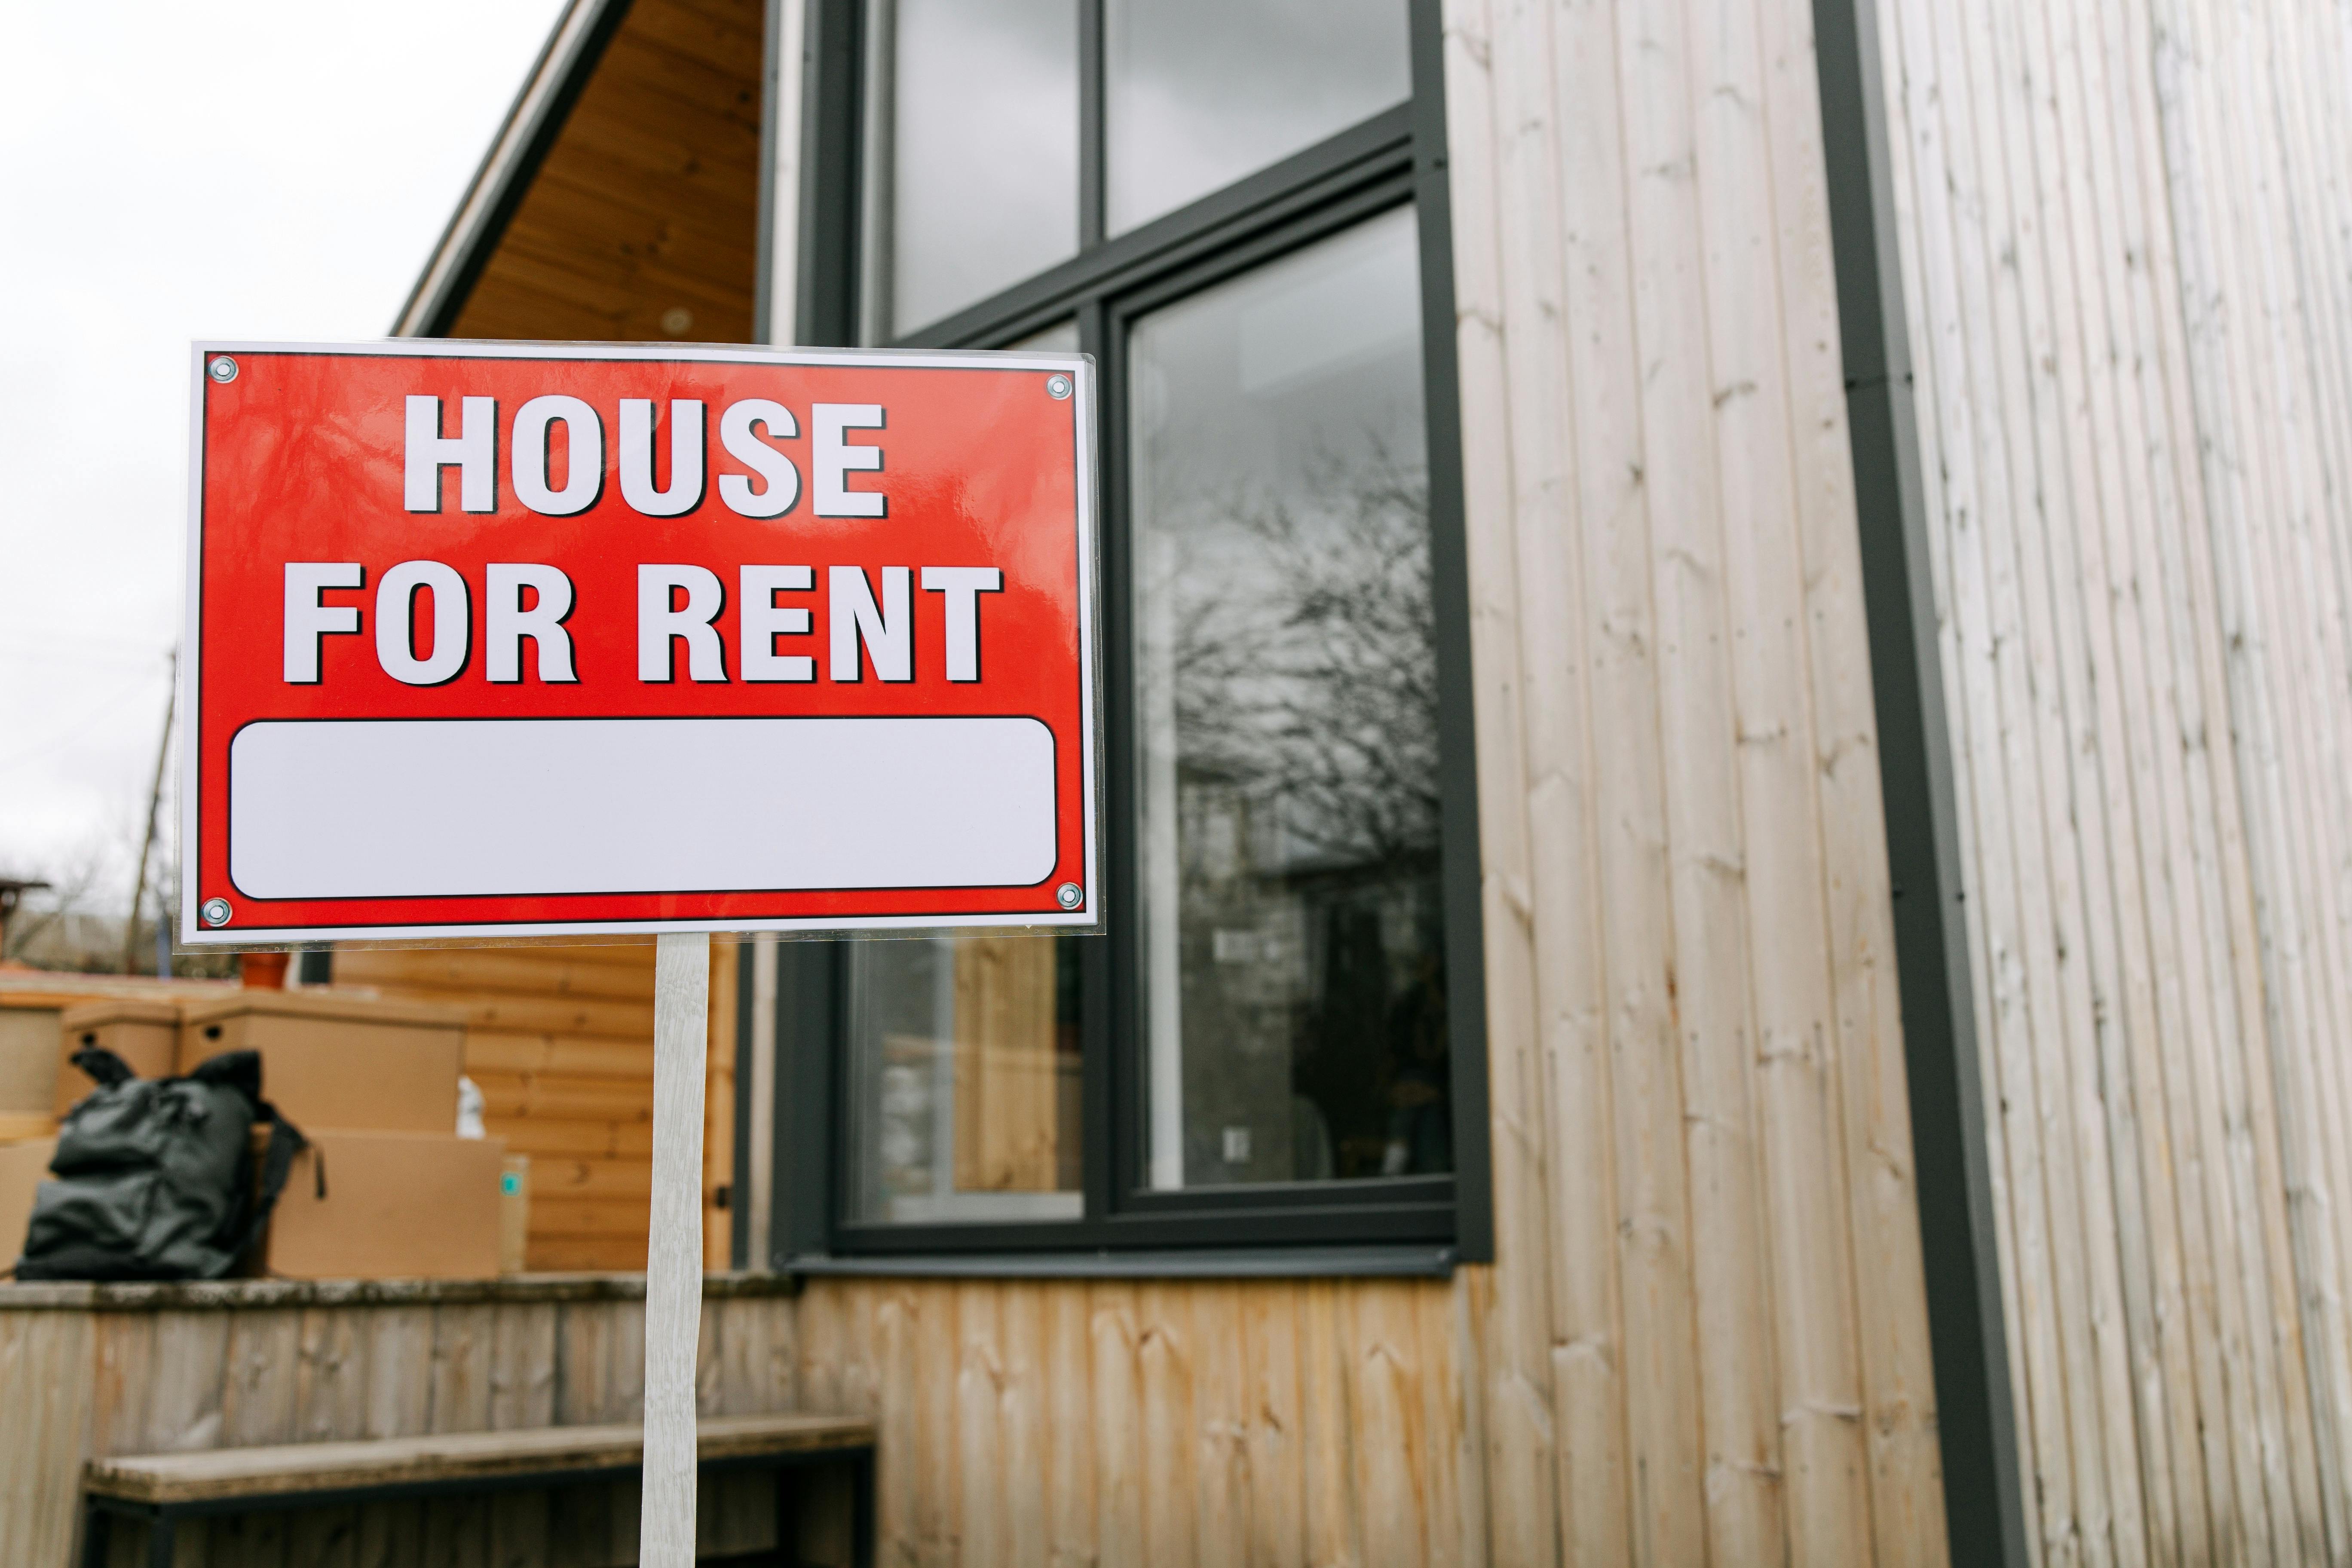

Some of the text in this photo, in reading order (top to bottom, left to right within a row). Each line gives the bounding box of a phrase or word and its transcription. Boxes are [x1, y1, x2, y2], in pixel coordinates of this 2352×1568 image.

[404, 395, 887, 518] HOUSE
[283, 560, 1003, 686] FOR RENT
